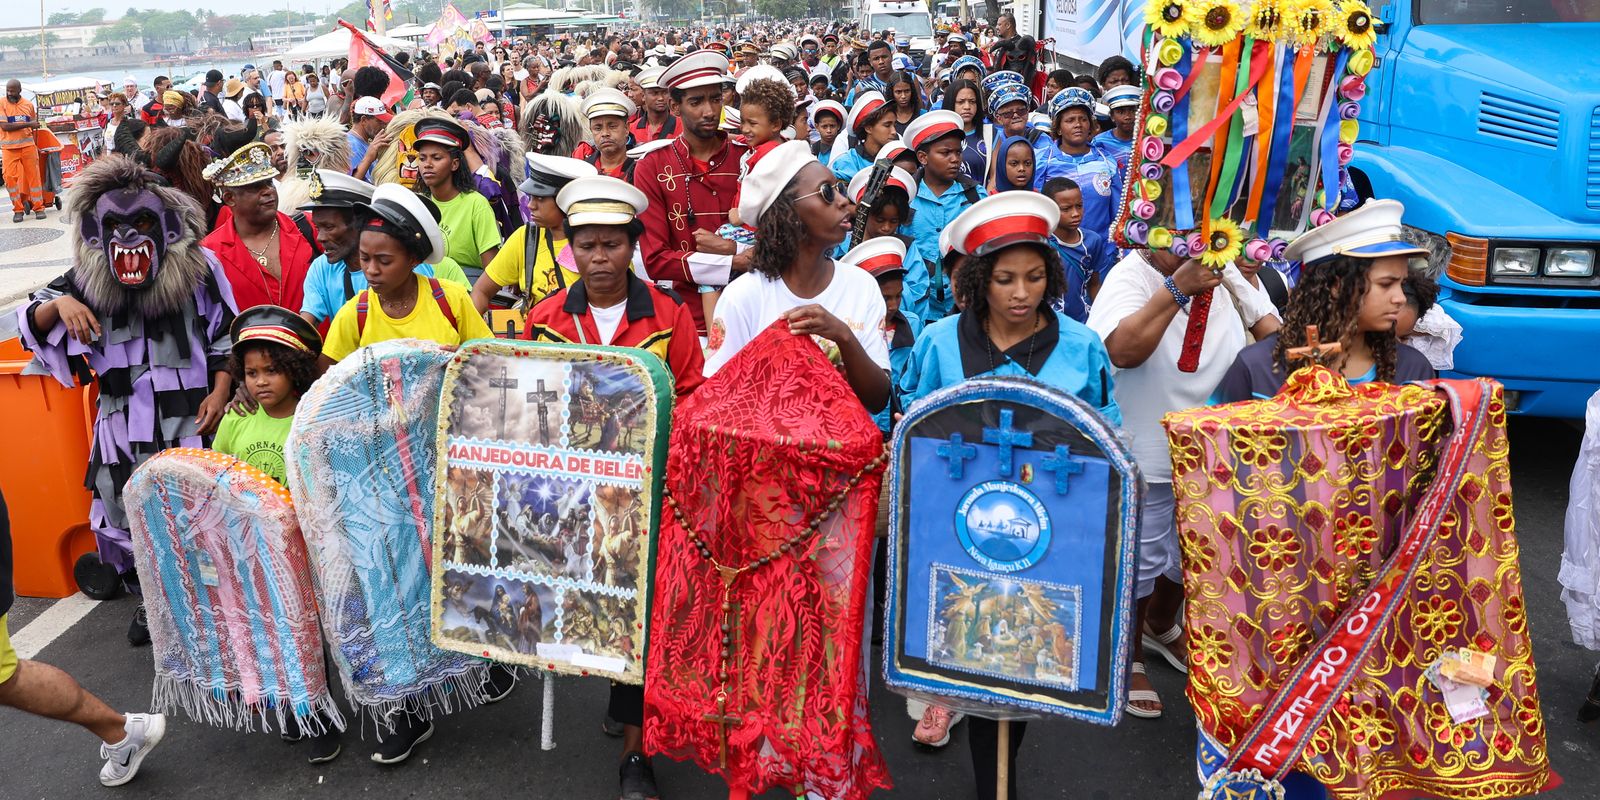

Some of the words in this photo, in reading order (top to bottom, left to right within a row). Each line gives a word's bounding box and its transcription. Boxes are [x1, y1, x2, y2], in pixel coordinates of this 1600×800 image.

[246, 441, 284, 456] JORNAD
[447, 444, 563, 471] MANJEDOURA
[567, 457, 590, 474] DE
[958, 487, 984, 517] Jornada
[982, 481, 1036, 505] Manjedoura
[1033, 501, 1049, 530] Mirim
[967, 546, 987, 565] Nova
[988, 558, 1015, 573] Iguaçu
[1347, 591, 1381, 635] DO
[1254, 646, 1347, 766] ORIENTE
